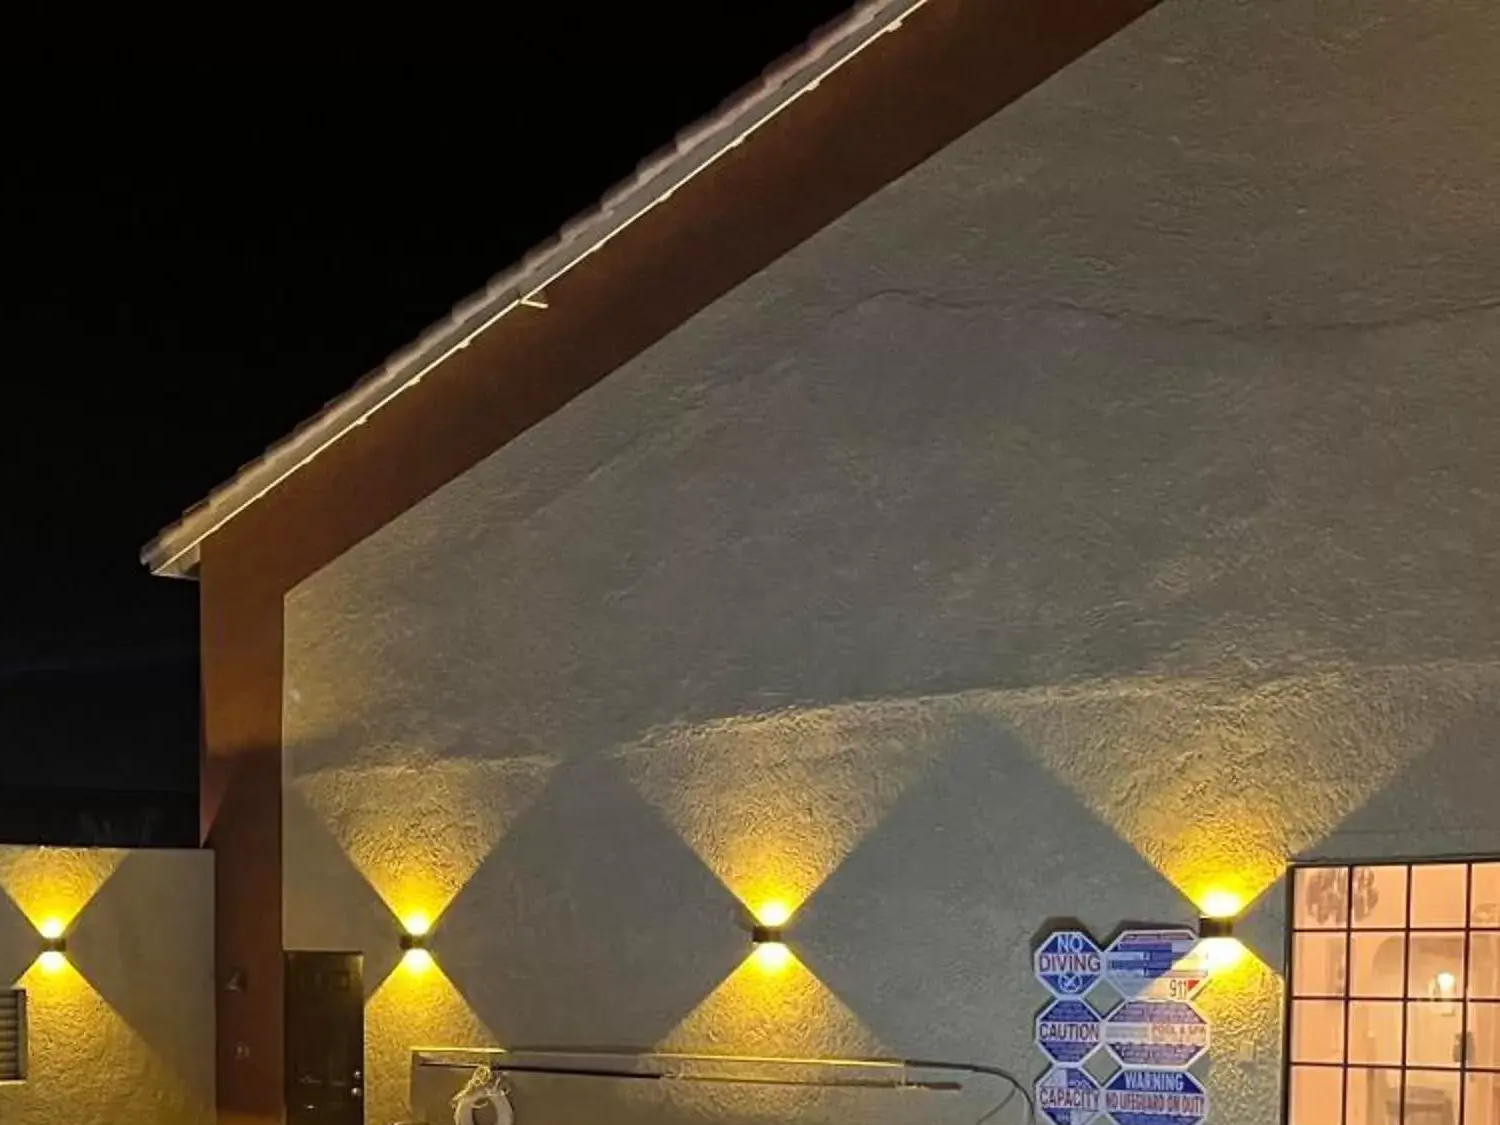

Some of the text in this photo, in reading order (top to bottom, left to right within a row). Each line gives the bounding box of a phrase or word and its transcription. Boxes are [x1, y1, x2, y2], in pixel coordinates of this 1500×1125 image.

[1057, 934, 1083, 952] NO
[1040, 954, 1101, 972] DIVING
[1169, 979, 1188, 999] 911
[1040, 1022, 1100, 1040] CAUTION
[1124, 1071, 1185, 1090] WARNING
[1040, 1087, 1100, 1110] CAPACITY
